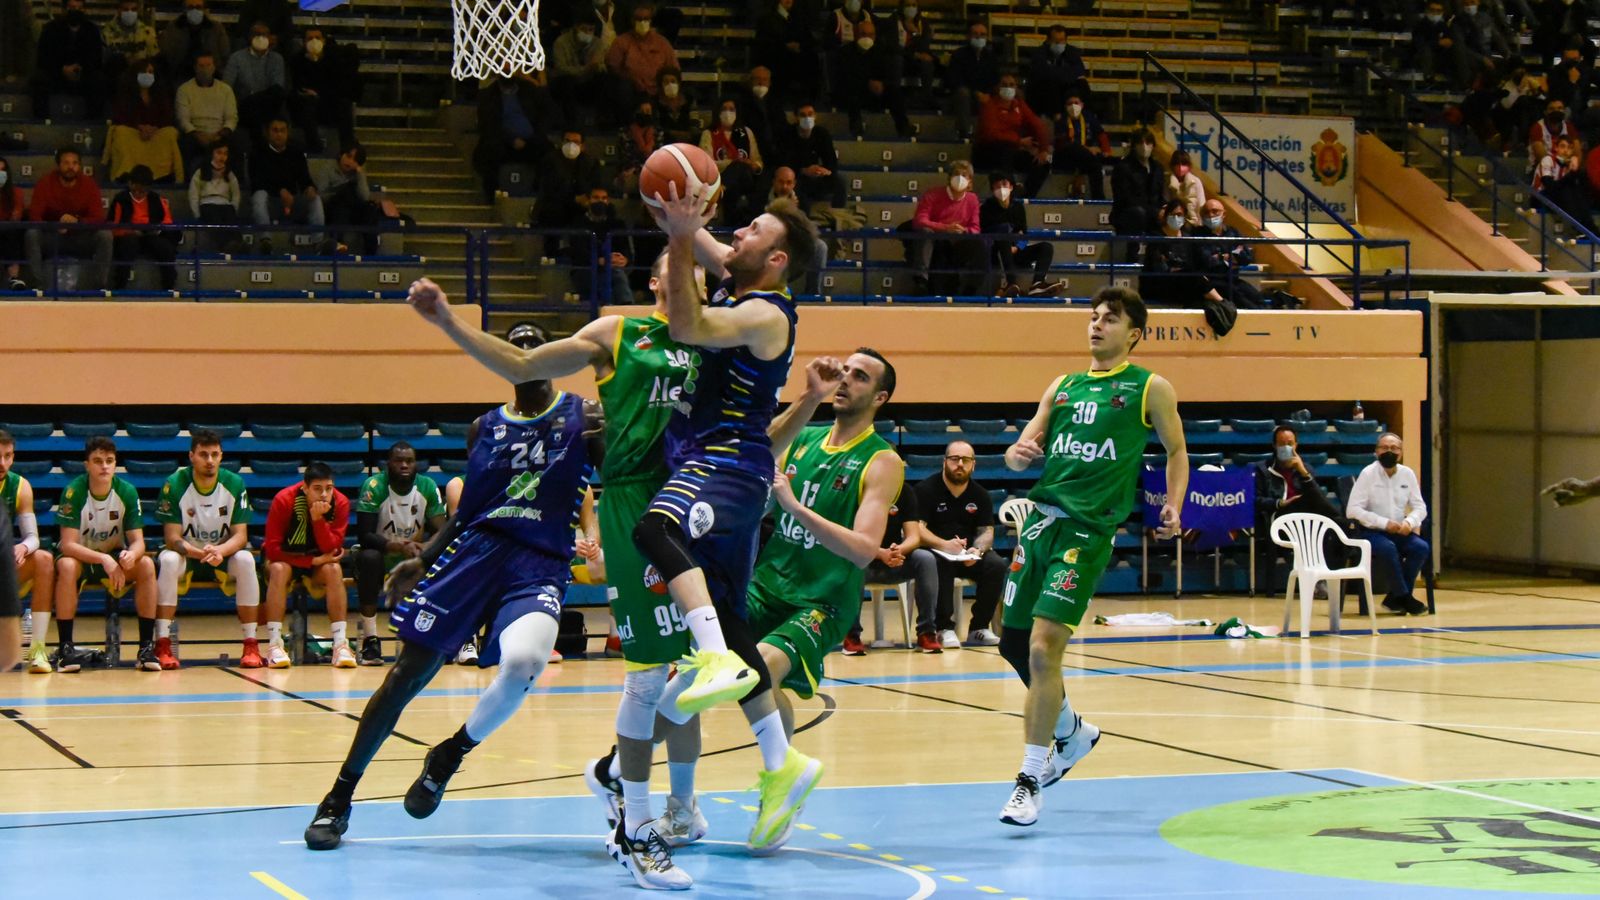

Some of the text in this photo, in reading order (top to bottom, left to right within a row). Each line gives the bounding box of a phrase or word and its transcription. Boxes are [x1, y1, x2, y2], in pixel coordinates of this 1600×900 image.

[1292, 326, 1320, 341] TV
[1072, 401, 1098, 424] 30
[511, 440, 546, 470] 24
[1190, 490, 1246, 507] molten
[654, 602, 688, 636] 99
